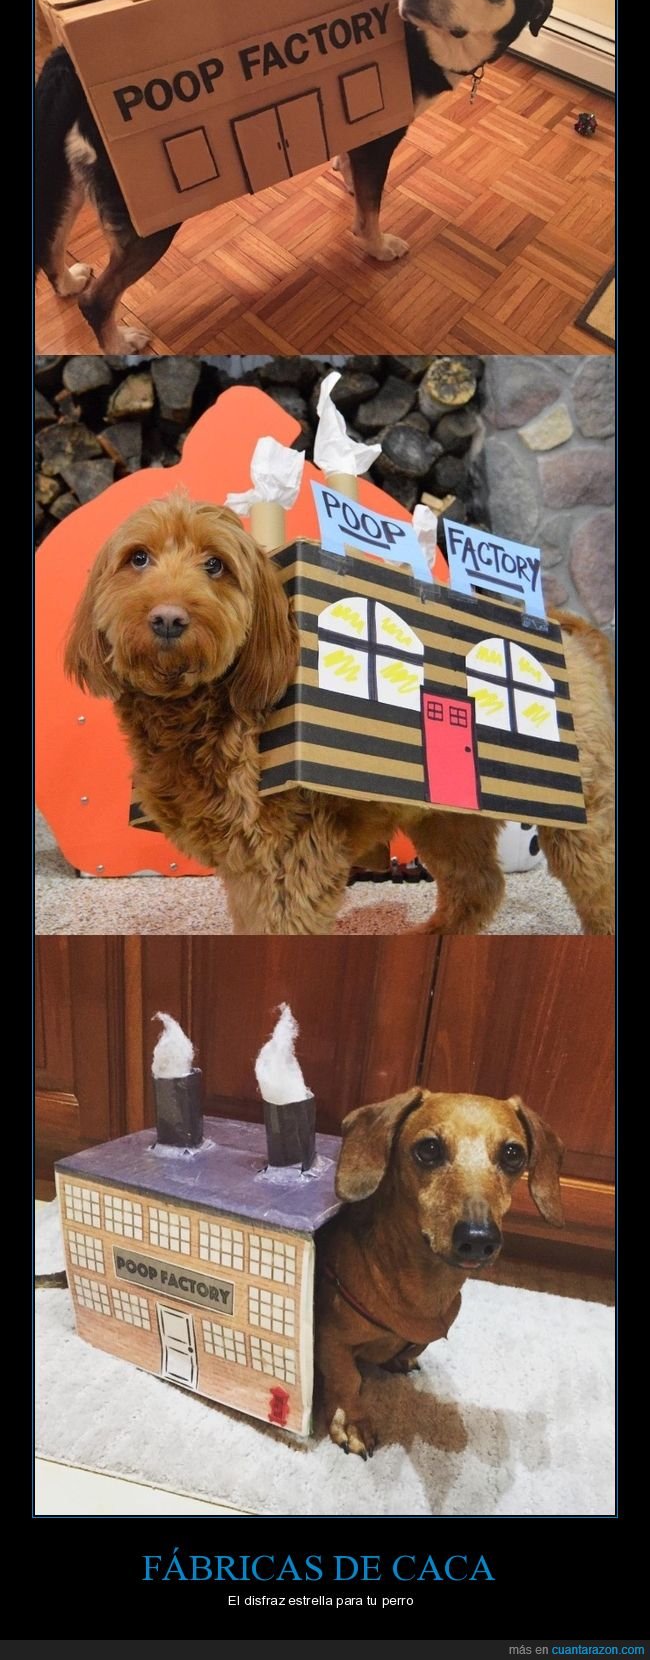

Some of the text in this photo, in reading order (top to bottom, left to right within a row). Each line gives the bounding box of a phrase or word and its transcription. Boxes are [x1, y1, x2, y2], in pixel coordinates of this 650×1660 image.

[113, 3, 390, 122] POOP FACTORY
[321, 490, 541, 592] POOP FACTORY
[116, 1255, 231, 1305] POOP FACTORY
